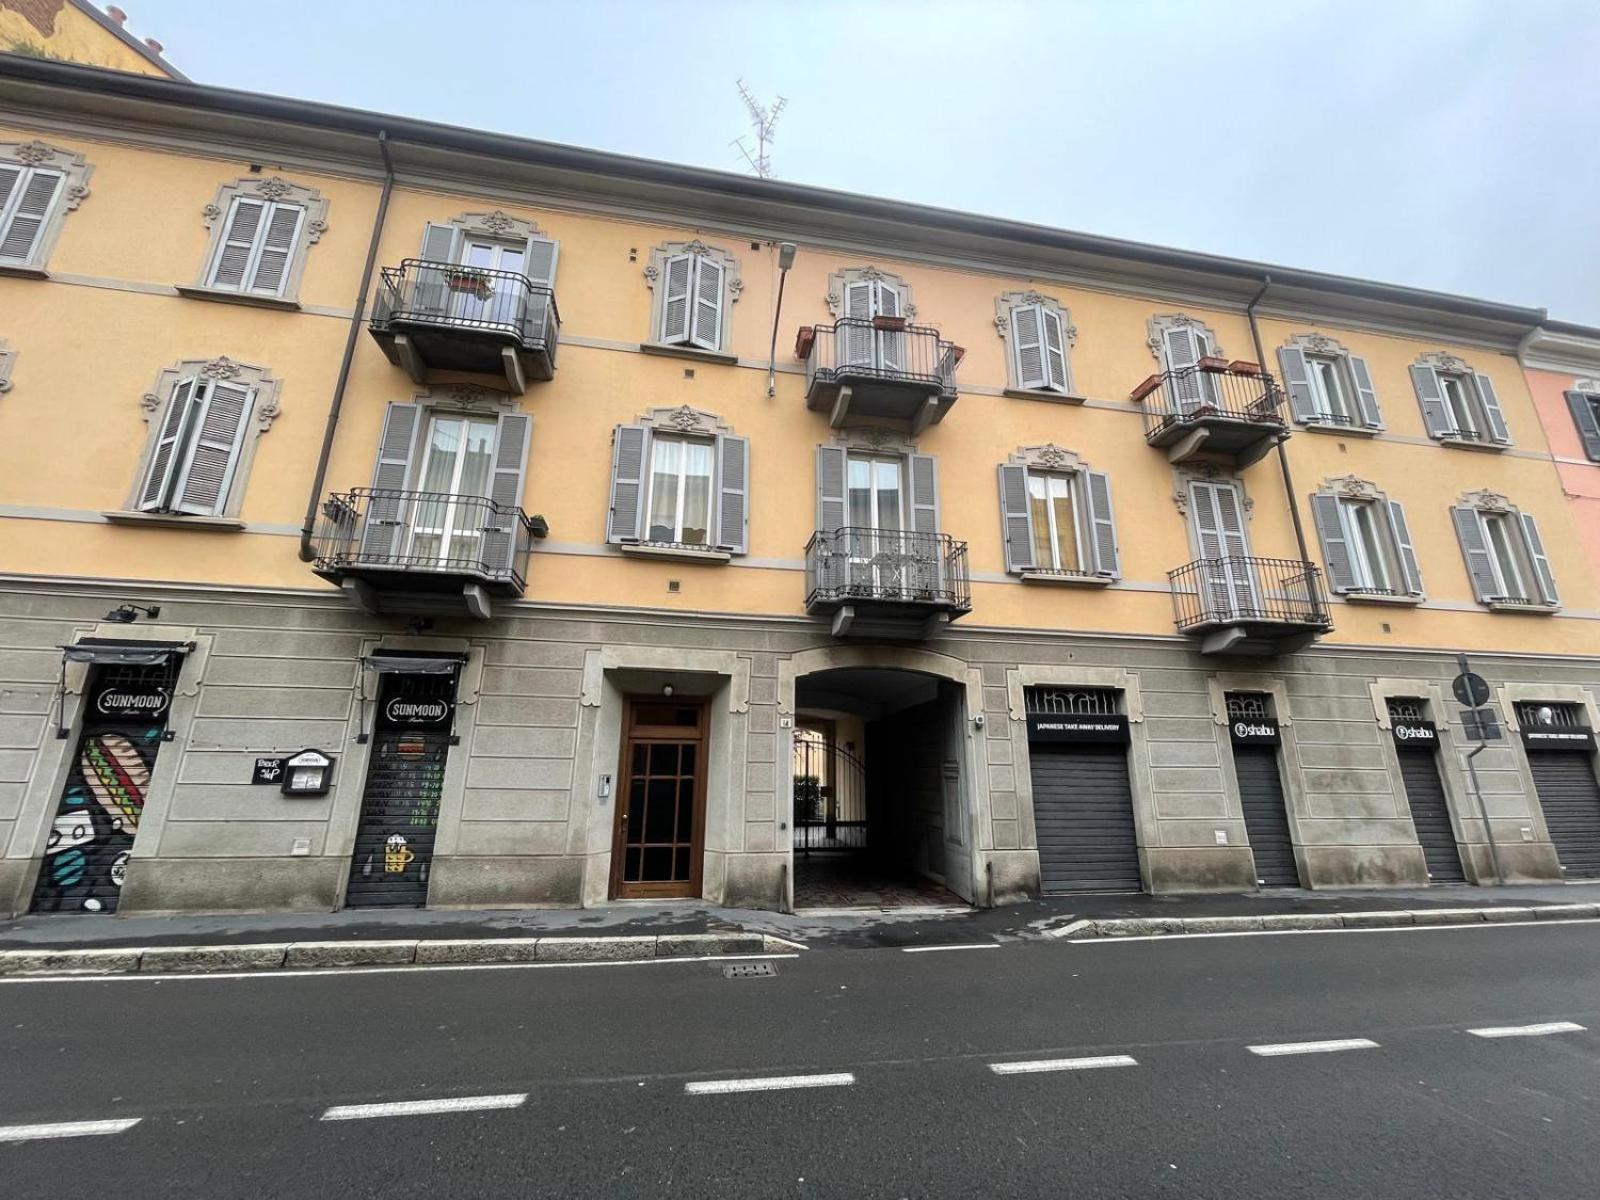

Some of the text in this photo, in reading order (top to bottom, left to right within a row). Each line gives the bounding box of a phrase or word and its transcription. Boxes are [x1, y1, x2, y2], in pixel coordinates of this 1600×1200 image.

[104, 694, 163, 708] SUNMOON
[392, 703, 442, 716] SUNMOON
[1037, 723, 1063, 731] JAPANESE
[1247, 723, 1275, 736] shabu
[1407, 726, 1434, 738] shabu
